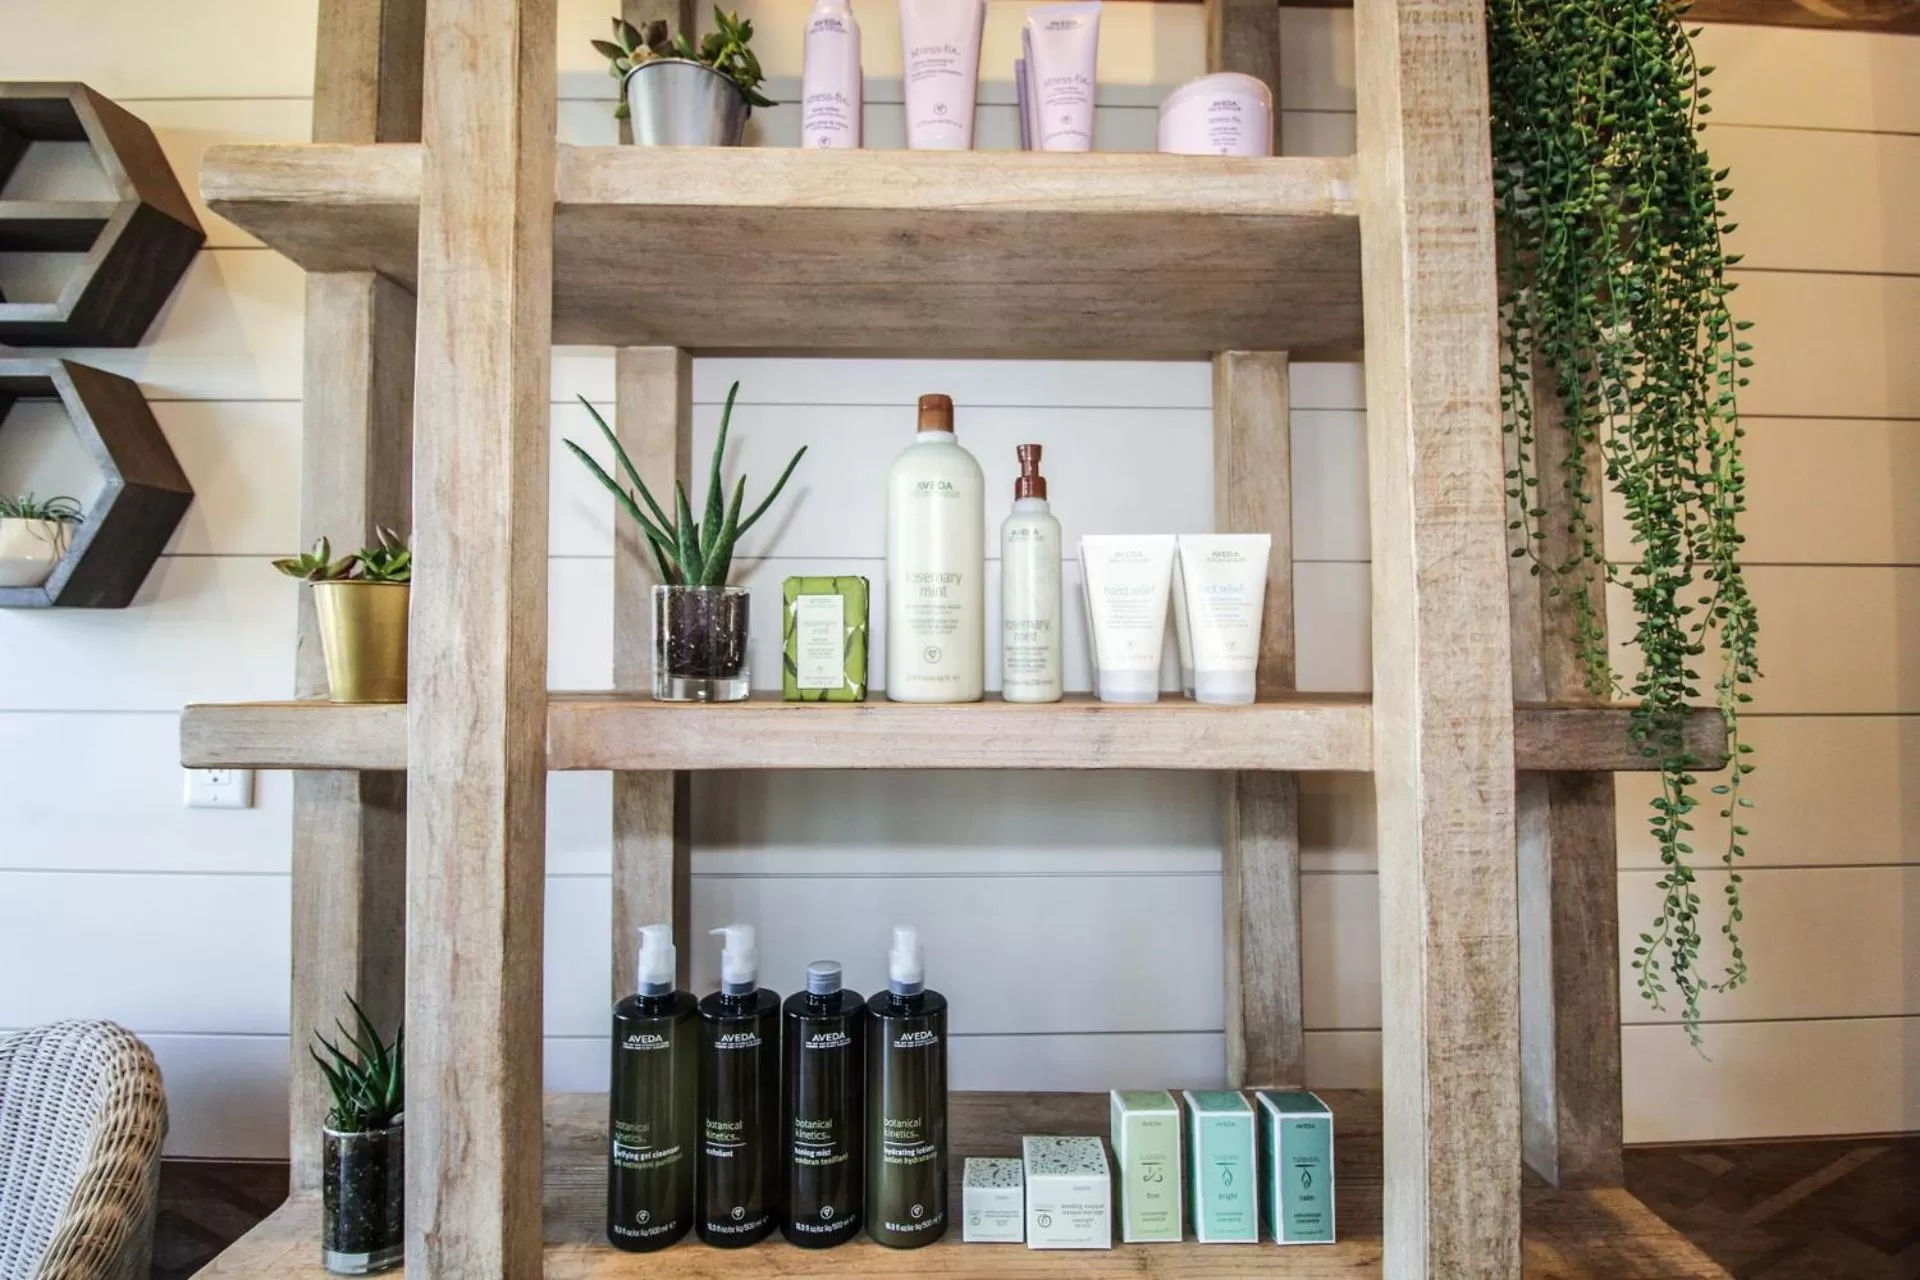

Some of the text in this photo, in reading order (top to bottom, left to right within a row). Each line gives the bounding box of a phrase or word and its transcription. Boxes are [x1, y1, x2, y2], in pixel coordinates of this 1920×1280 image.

[916, 481, 953, 490] AVEDA
[628, 1034, 663, 1044] AVEDA
[721, 1032, 756, 1043] AVEDA
[812, 1031, 846, 1042] AVEDA
[900, 1030, 933, 1041] AVEDA
[706, 1118, 743, 1131] botanical
[795, 1118, 833, 1129] botanical
[884, 1117, 922, 1128] botanical
[706, 1130, 736, 1142] kinetics
[795, 1128, 827, 1140] kinetics
[884, 1127, 915, 1139] kinetics
